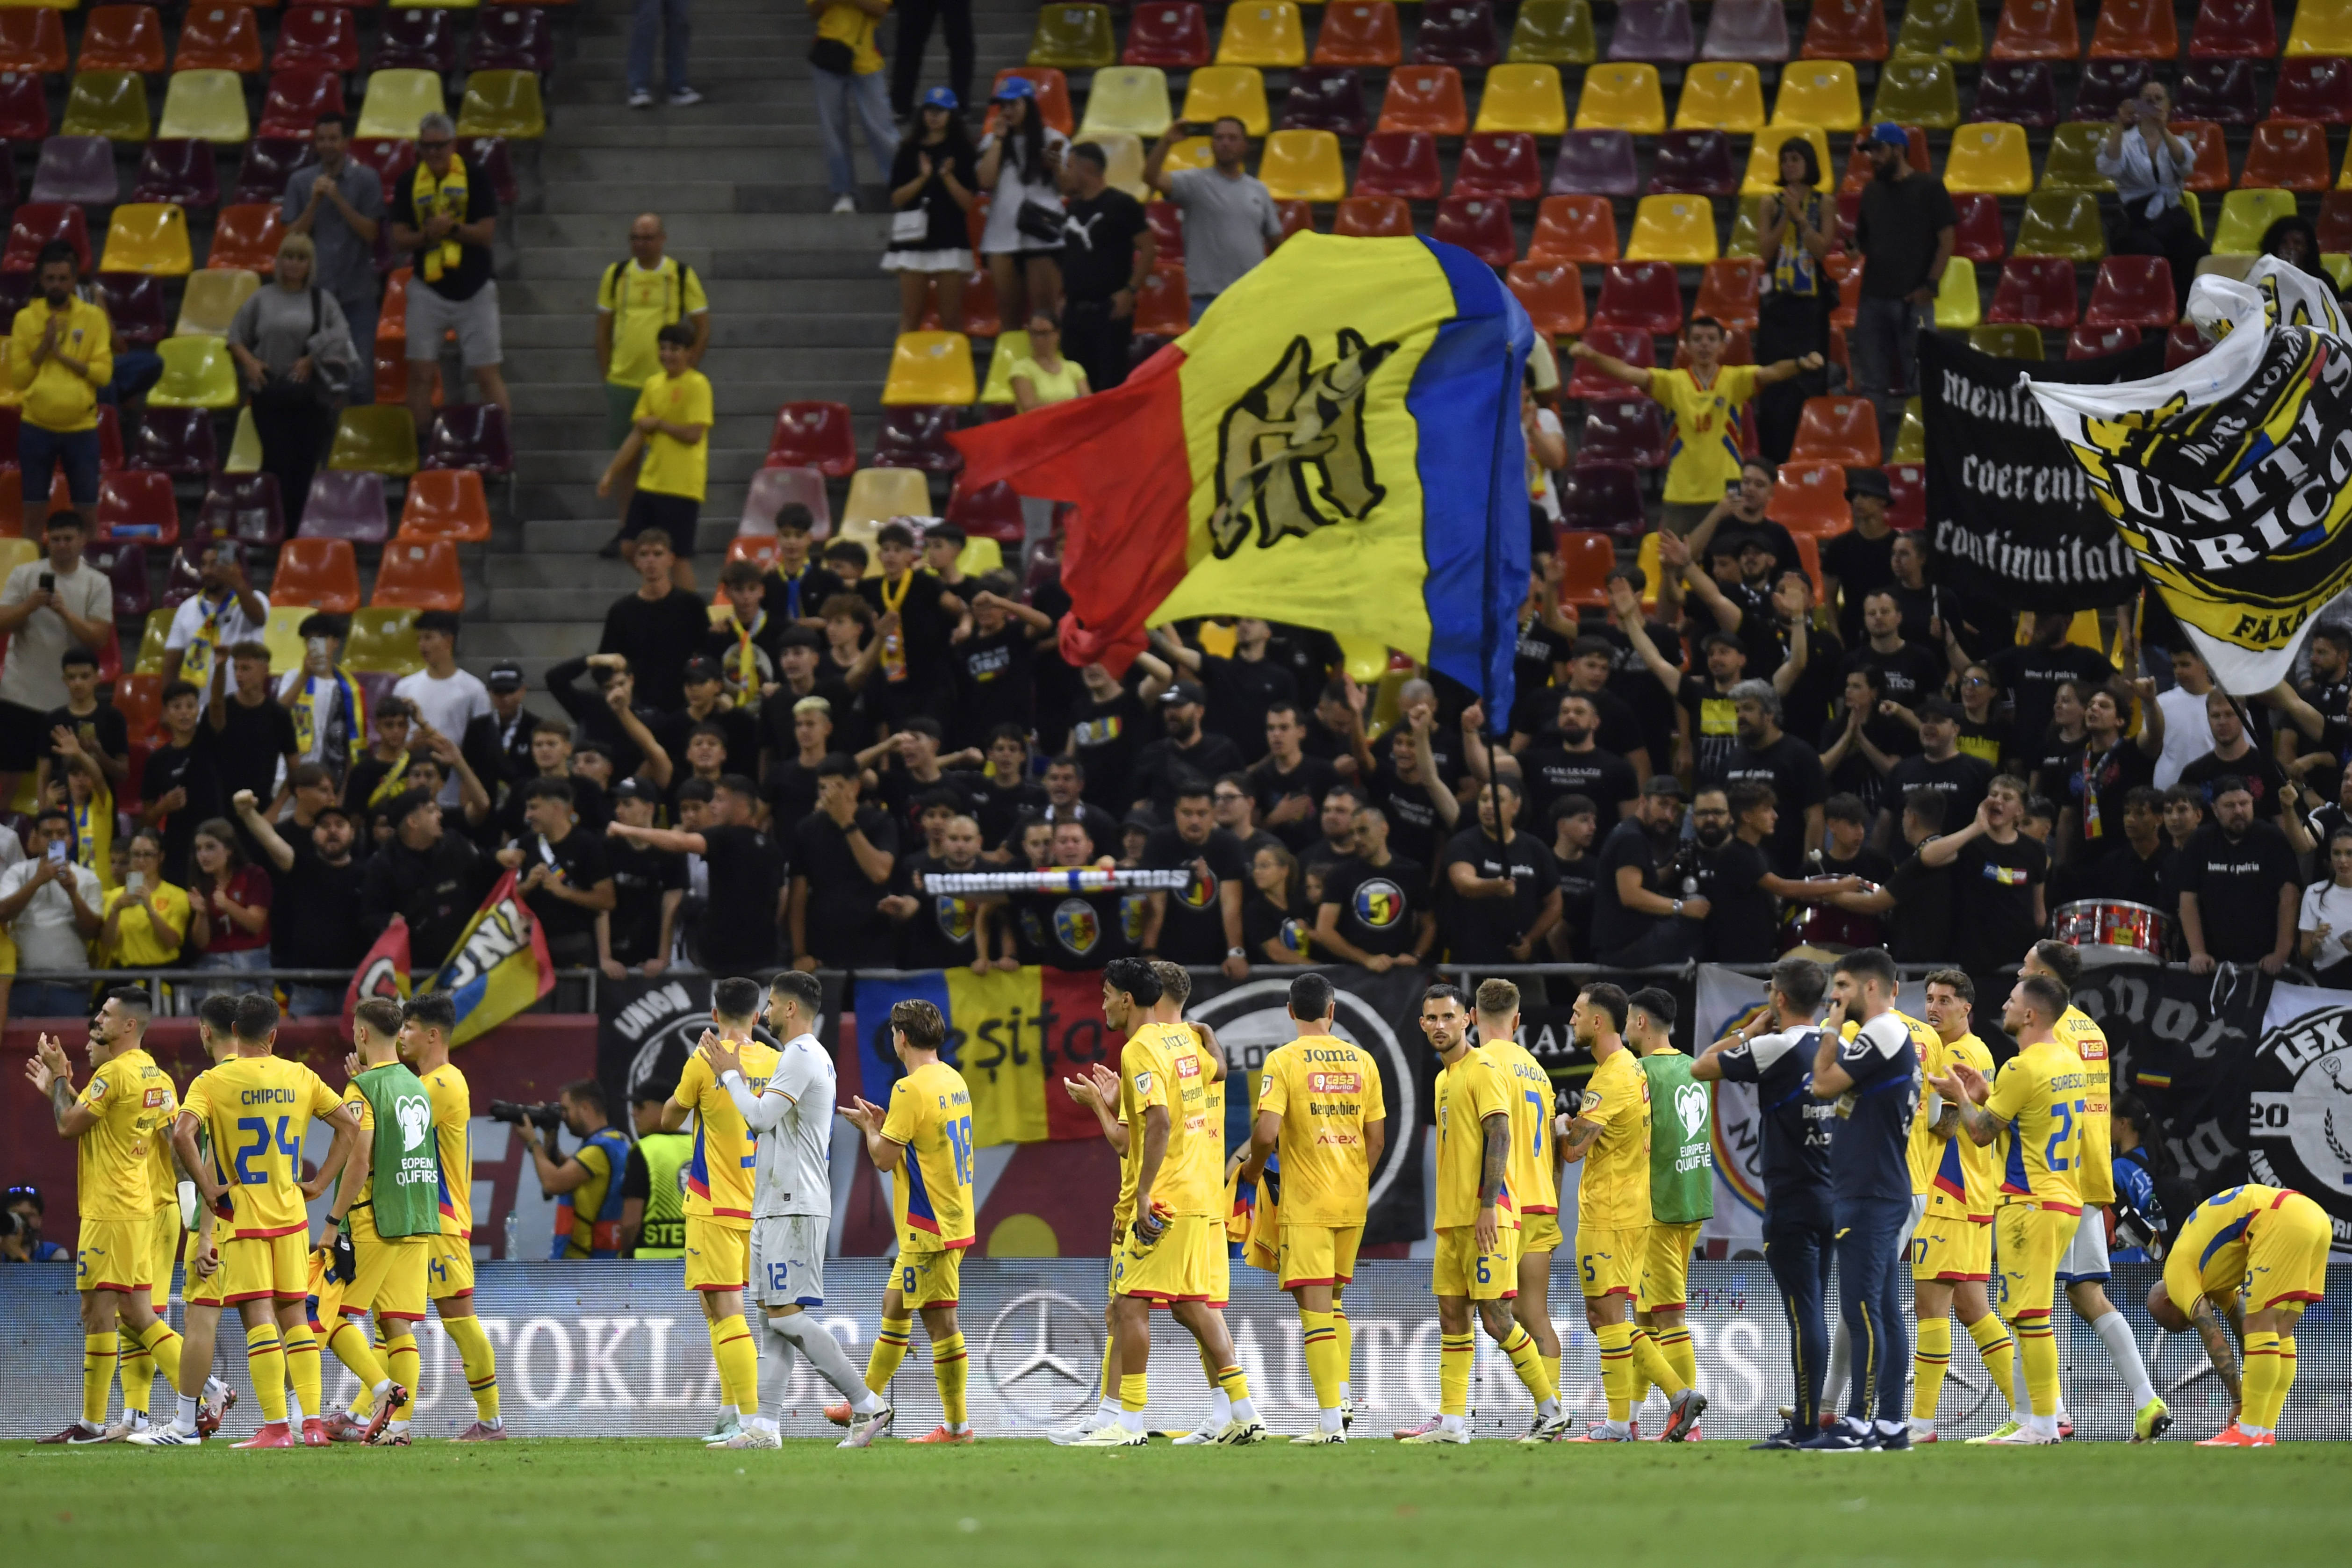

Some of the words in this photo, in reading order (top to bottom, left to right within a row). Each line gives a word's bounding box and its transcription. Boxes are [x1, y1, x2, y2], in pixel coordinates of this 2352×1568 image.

[2274, 1015, 2348, 1076] LEX
[93, 1082, 104, 1094] BT
[1139, 1077, 1149, 1089] BT
[1326, 1074, 1355, 1085] casa
[241, 1089, 295, 1106] CHIPCIU
[939, 1095, 949, 1110] R.
[1584, 1096, 1597, 1106] BT
[1310, 1100, 1361, 1118] Bergenbier
[1524, 1090, 1544, 1158] 7
[234, 1116, 300, 1185] 24
[767, 1262, 787, 1290] 12
[1476, 1256, 1491, 1284] 6
[1582, 1255, 1596, 1282] 5
